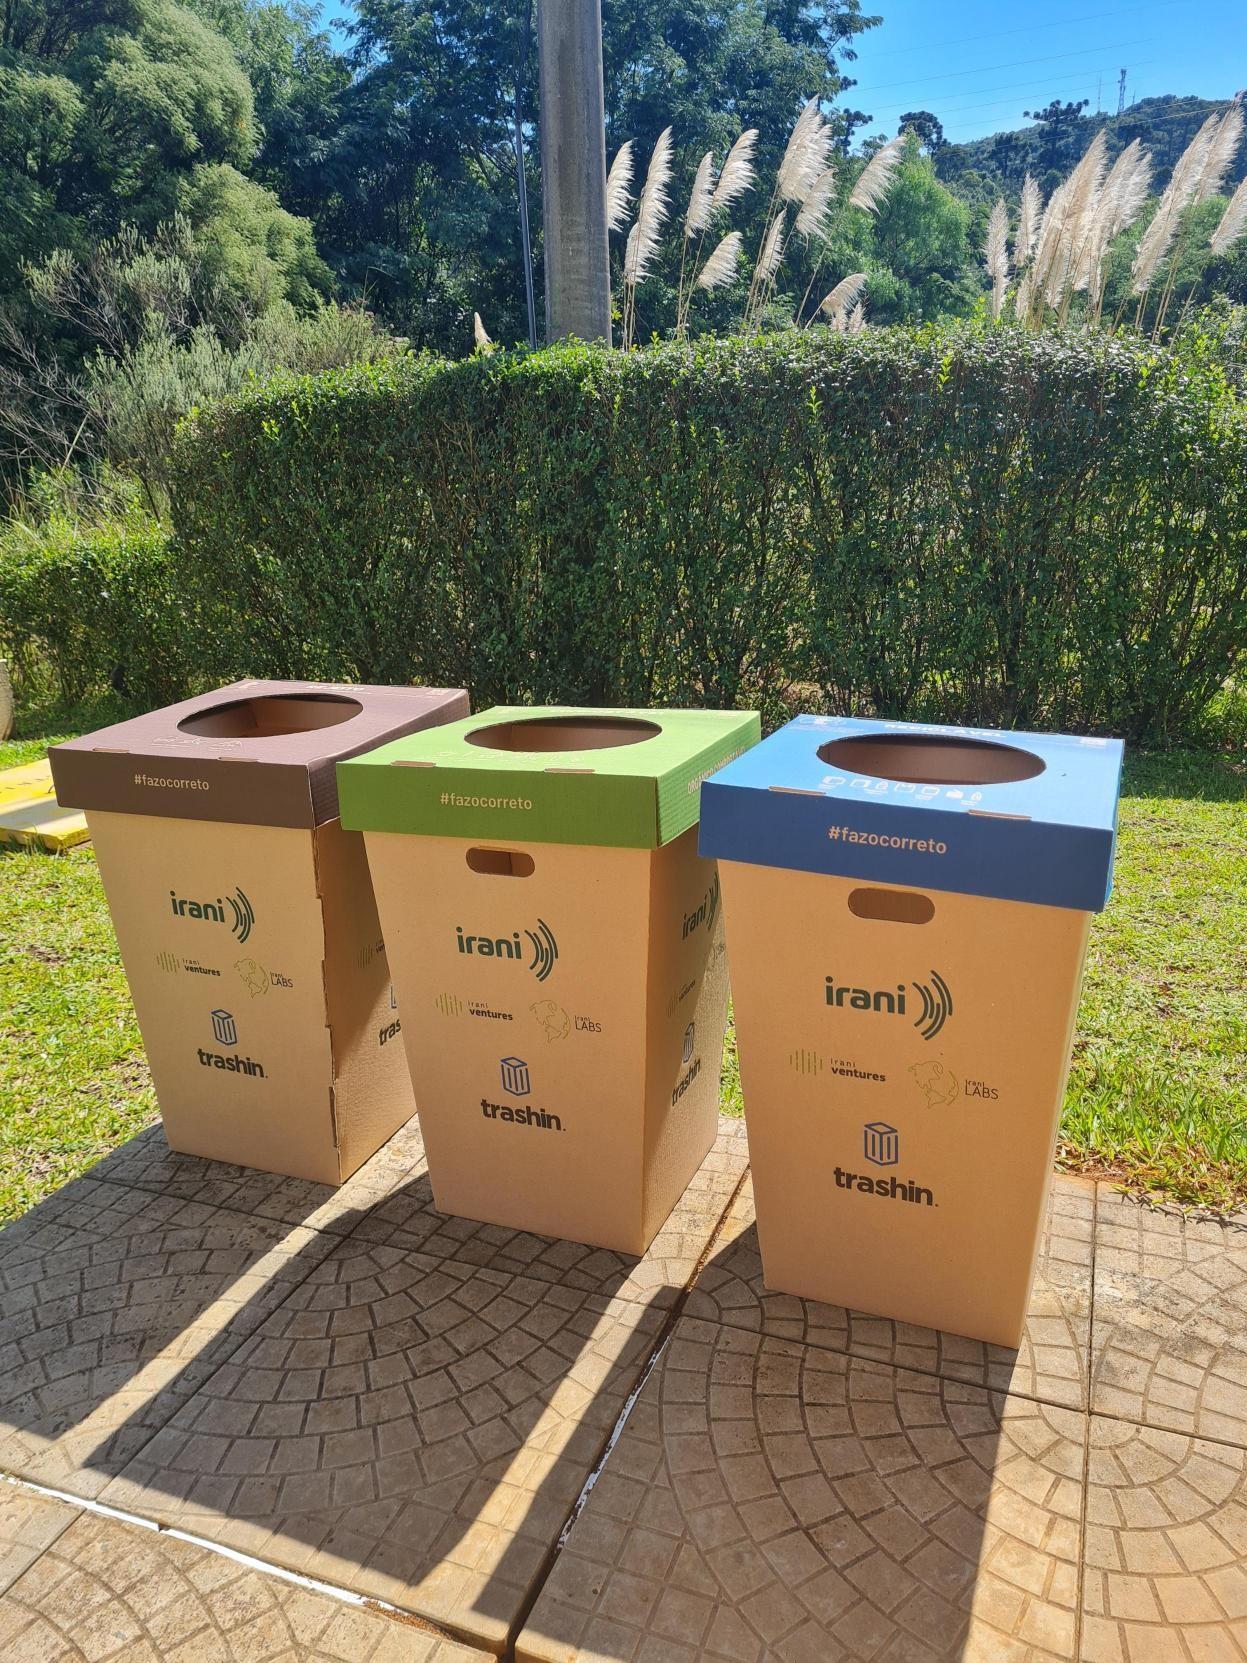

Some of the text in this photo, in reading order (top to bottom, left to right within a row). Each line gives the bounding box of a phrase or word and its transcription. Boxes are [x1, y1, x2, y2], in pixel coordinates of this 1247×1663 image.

[134, 773, 210, 791] #fazocorreto
[440, 792, 533, 810] #fazocorreto
[828, 825, 948, 854] #fazocorreto
[170, 890, 225, 923] irani
[682, 893, 707, 941] irani
[455, 926, 523, 960] irani
[184, 964, 222, 977] ventures
[270, 974, 295, 989] LABS
[825, 975, 906, 1015] irani
[468, 1007, 514, 1021] ventures
[379, 1018, 401, 1046] tras
[574, 1020, 602, 1033] LABS
[831, 1066, 886, 1082] ventures
[964, 1084, 1000, 1101] LABS
